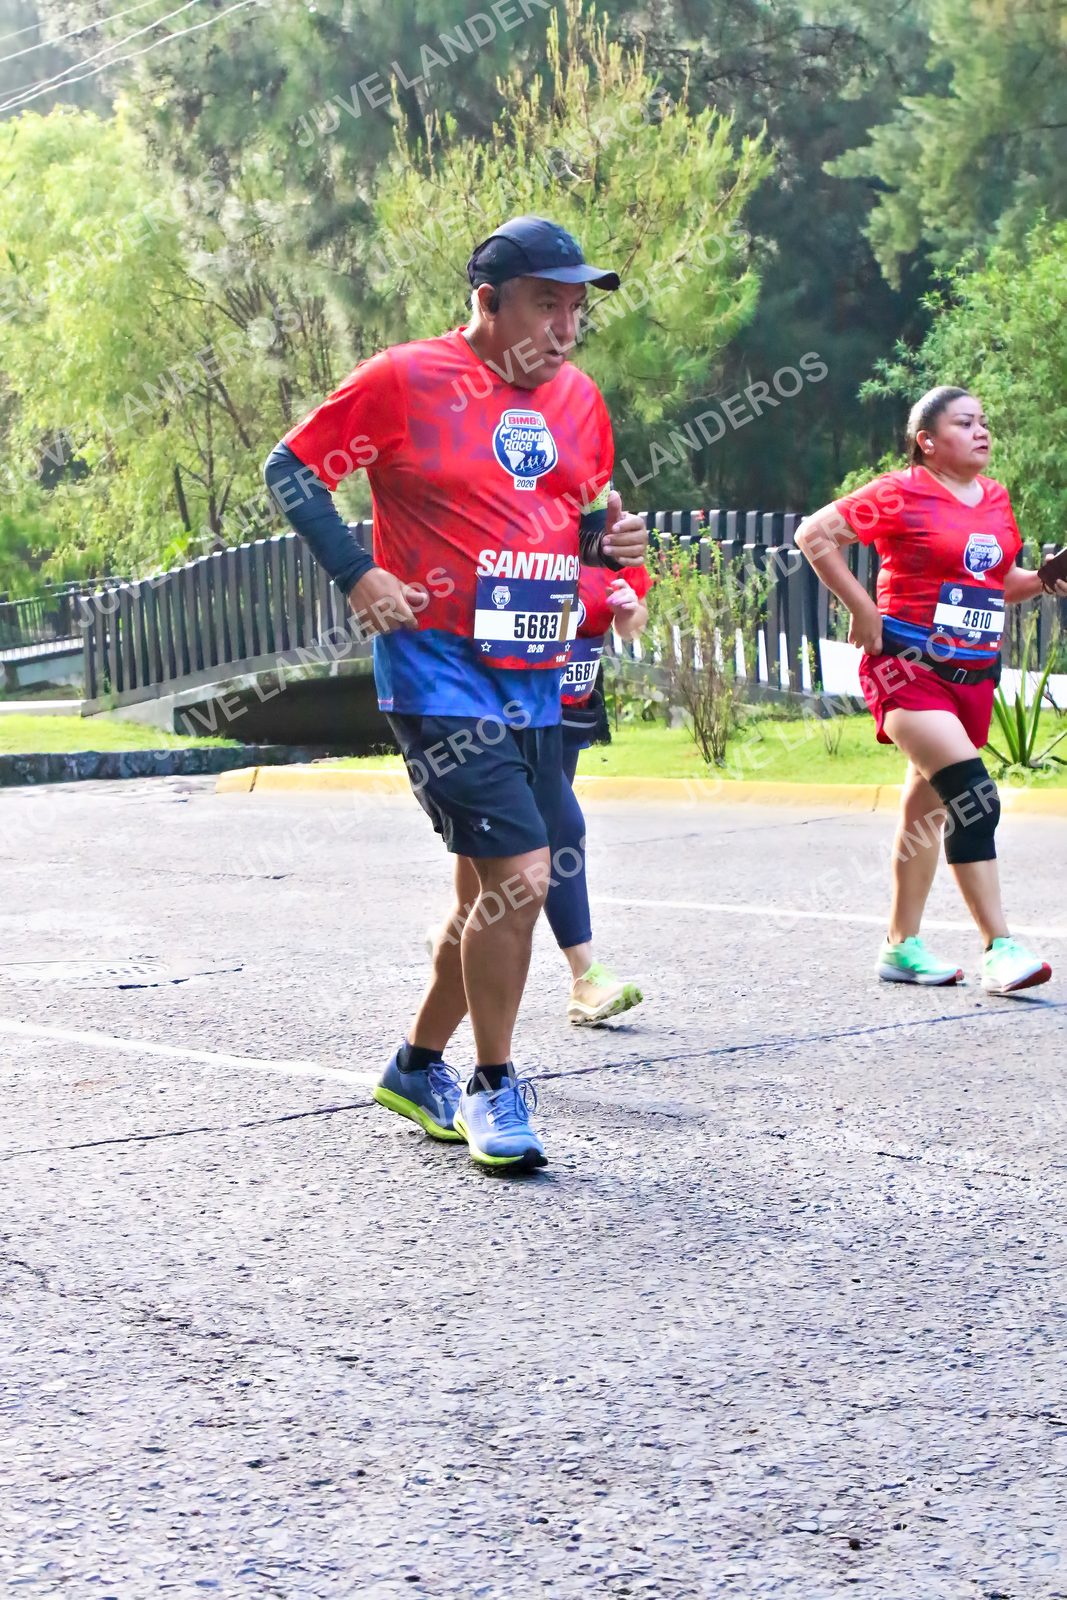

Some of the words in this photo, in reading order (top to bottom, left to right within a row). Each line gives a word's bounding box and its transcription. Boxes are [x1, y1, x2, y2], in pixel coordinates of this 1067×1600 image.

[504, 438, 533, 451] Race
[516, 480, 534, 488] 2026
[476, 549, 580, 581] SANTIAGO
[514, 614, 558, 638] 5683
[963, 610, 992, 629] 4810
[566, 663, 595, 681] 5681
